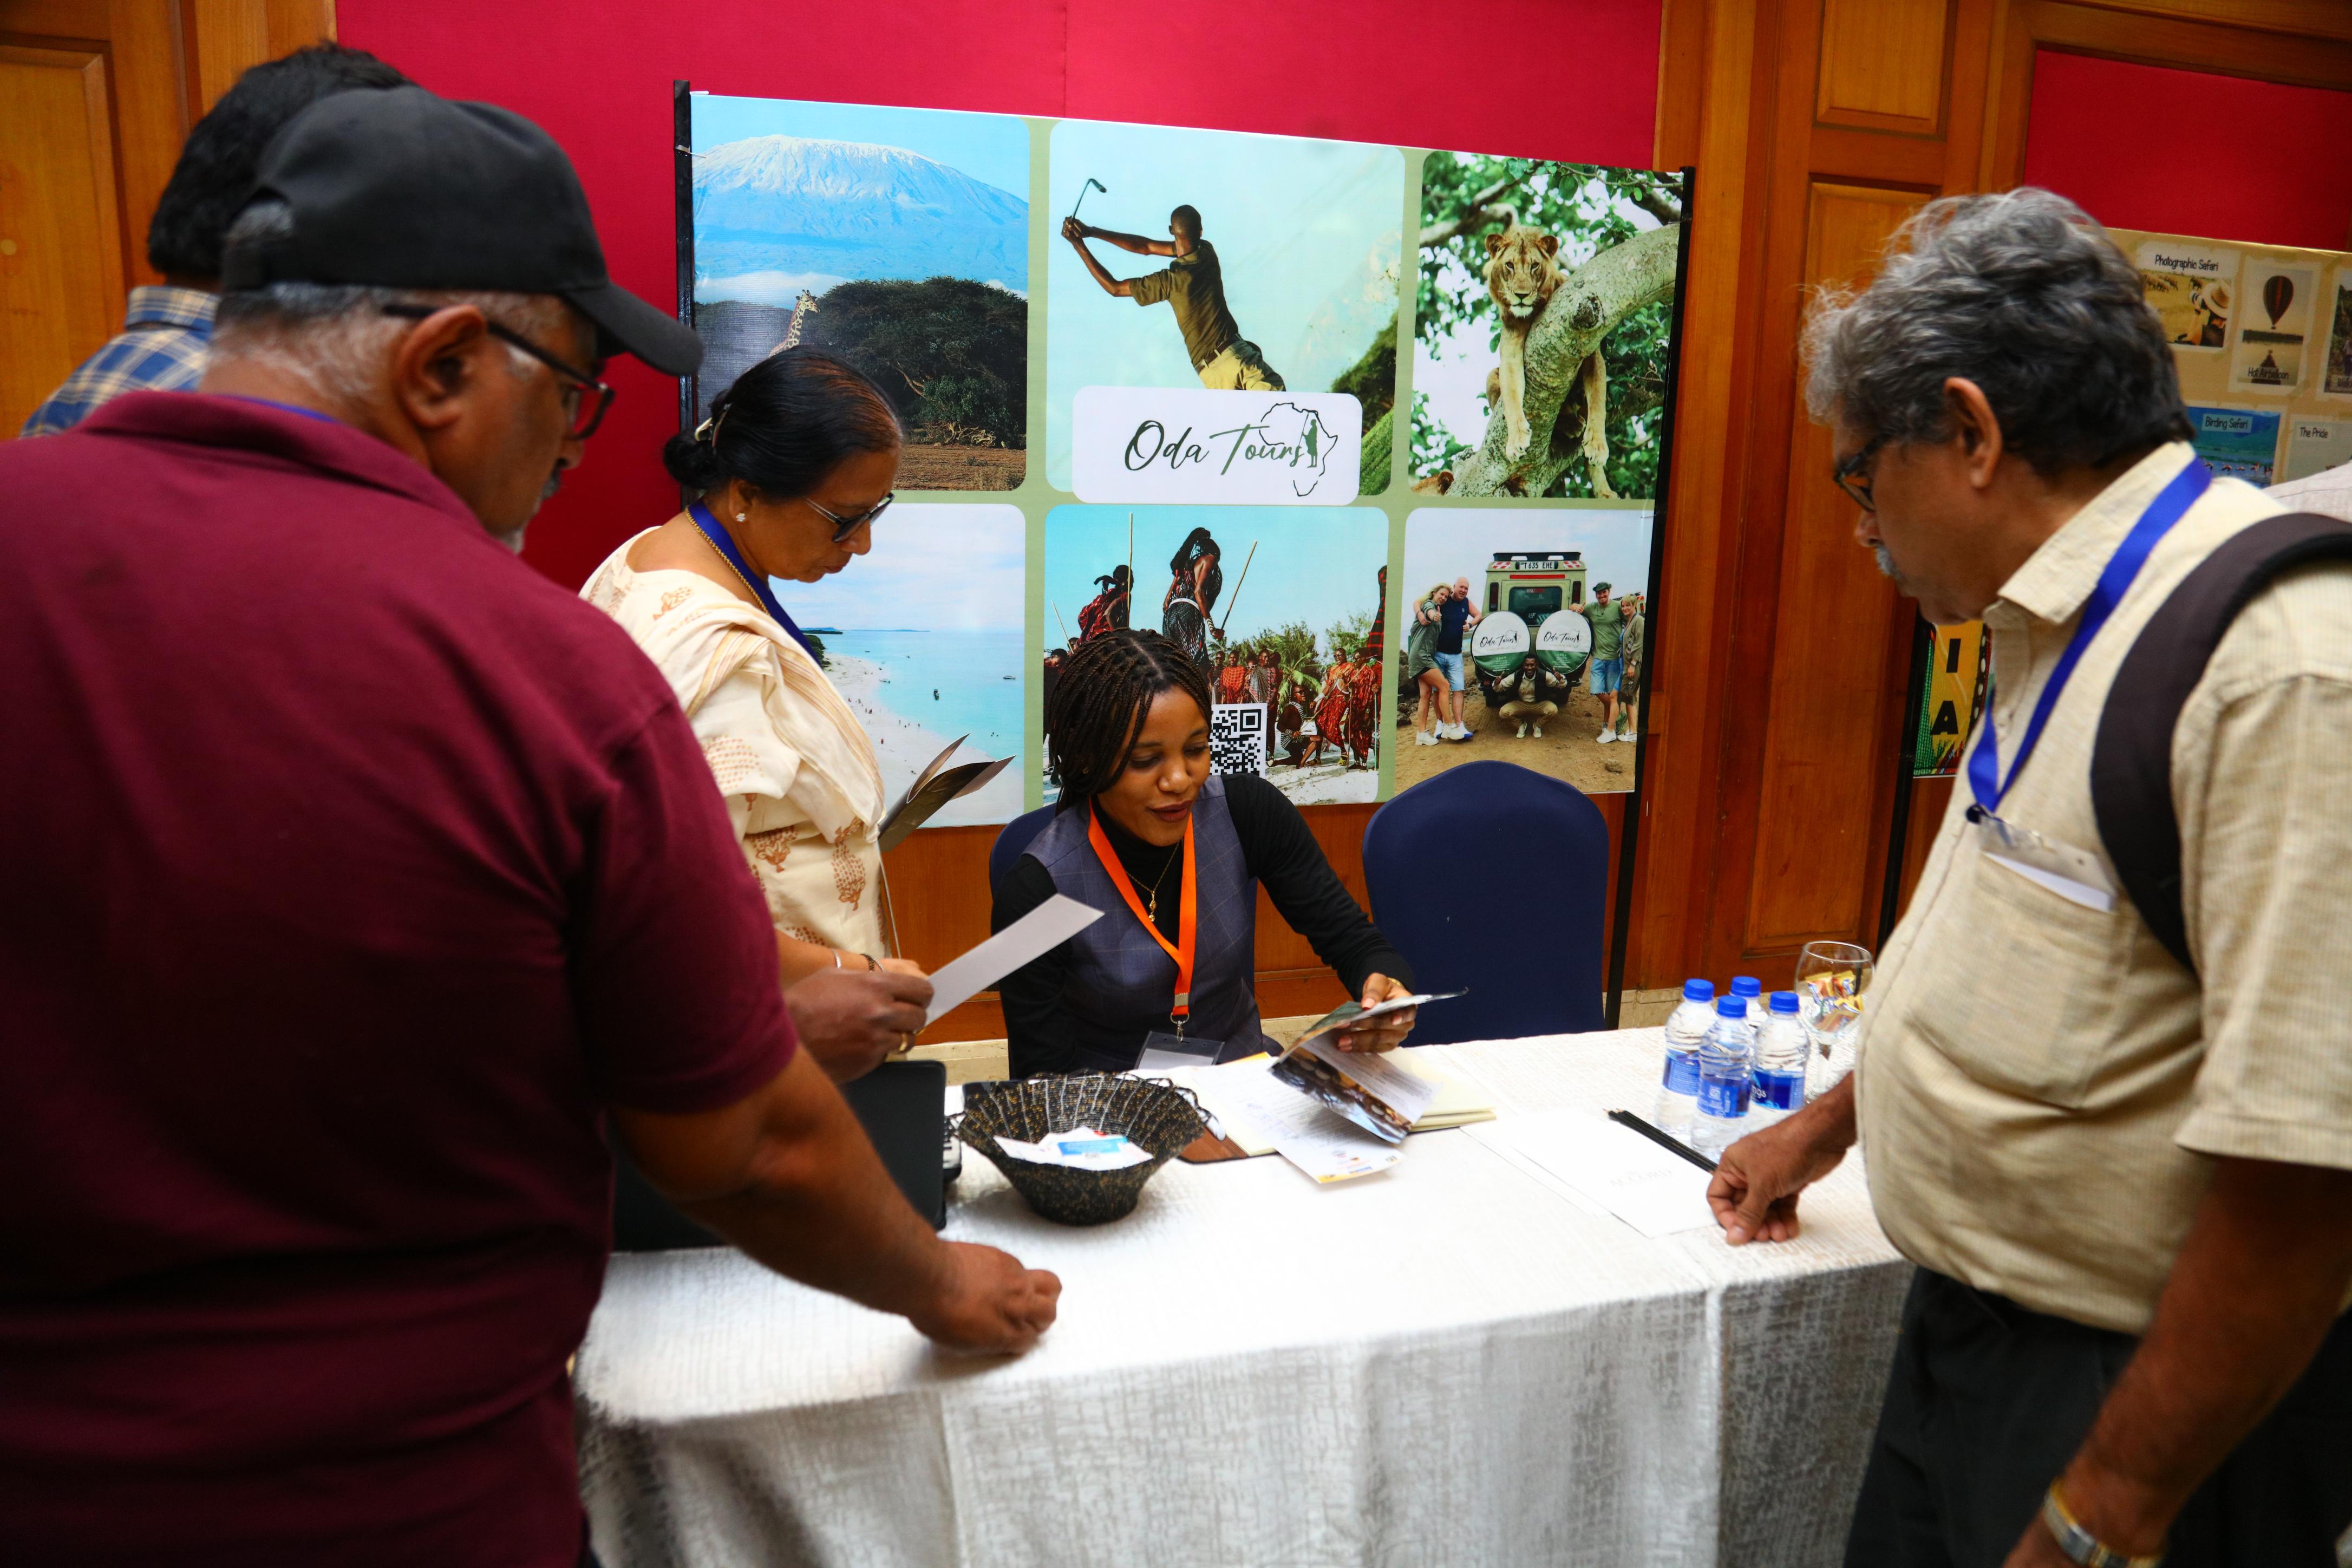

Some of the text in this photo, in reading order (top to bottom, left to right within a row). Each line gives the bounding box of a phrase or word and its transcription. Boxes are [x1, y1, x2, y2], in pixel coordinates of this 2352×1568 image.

[2155, 254, 2219, 271] Photographic Safari
[2248, 367, 2258, 377] Hot
[2205, 416, 2248, 430] Birding Safari
[2299, 427, 2328, 439] The Pride
[1124, 420, 1304, 475] Oda Tours
[1480, 635, 1514, 648] Oda Tours
[1544, 631, 1577, 643] Oda Tours
